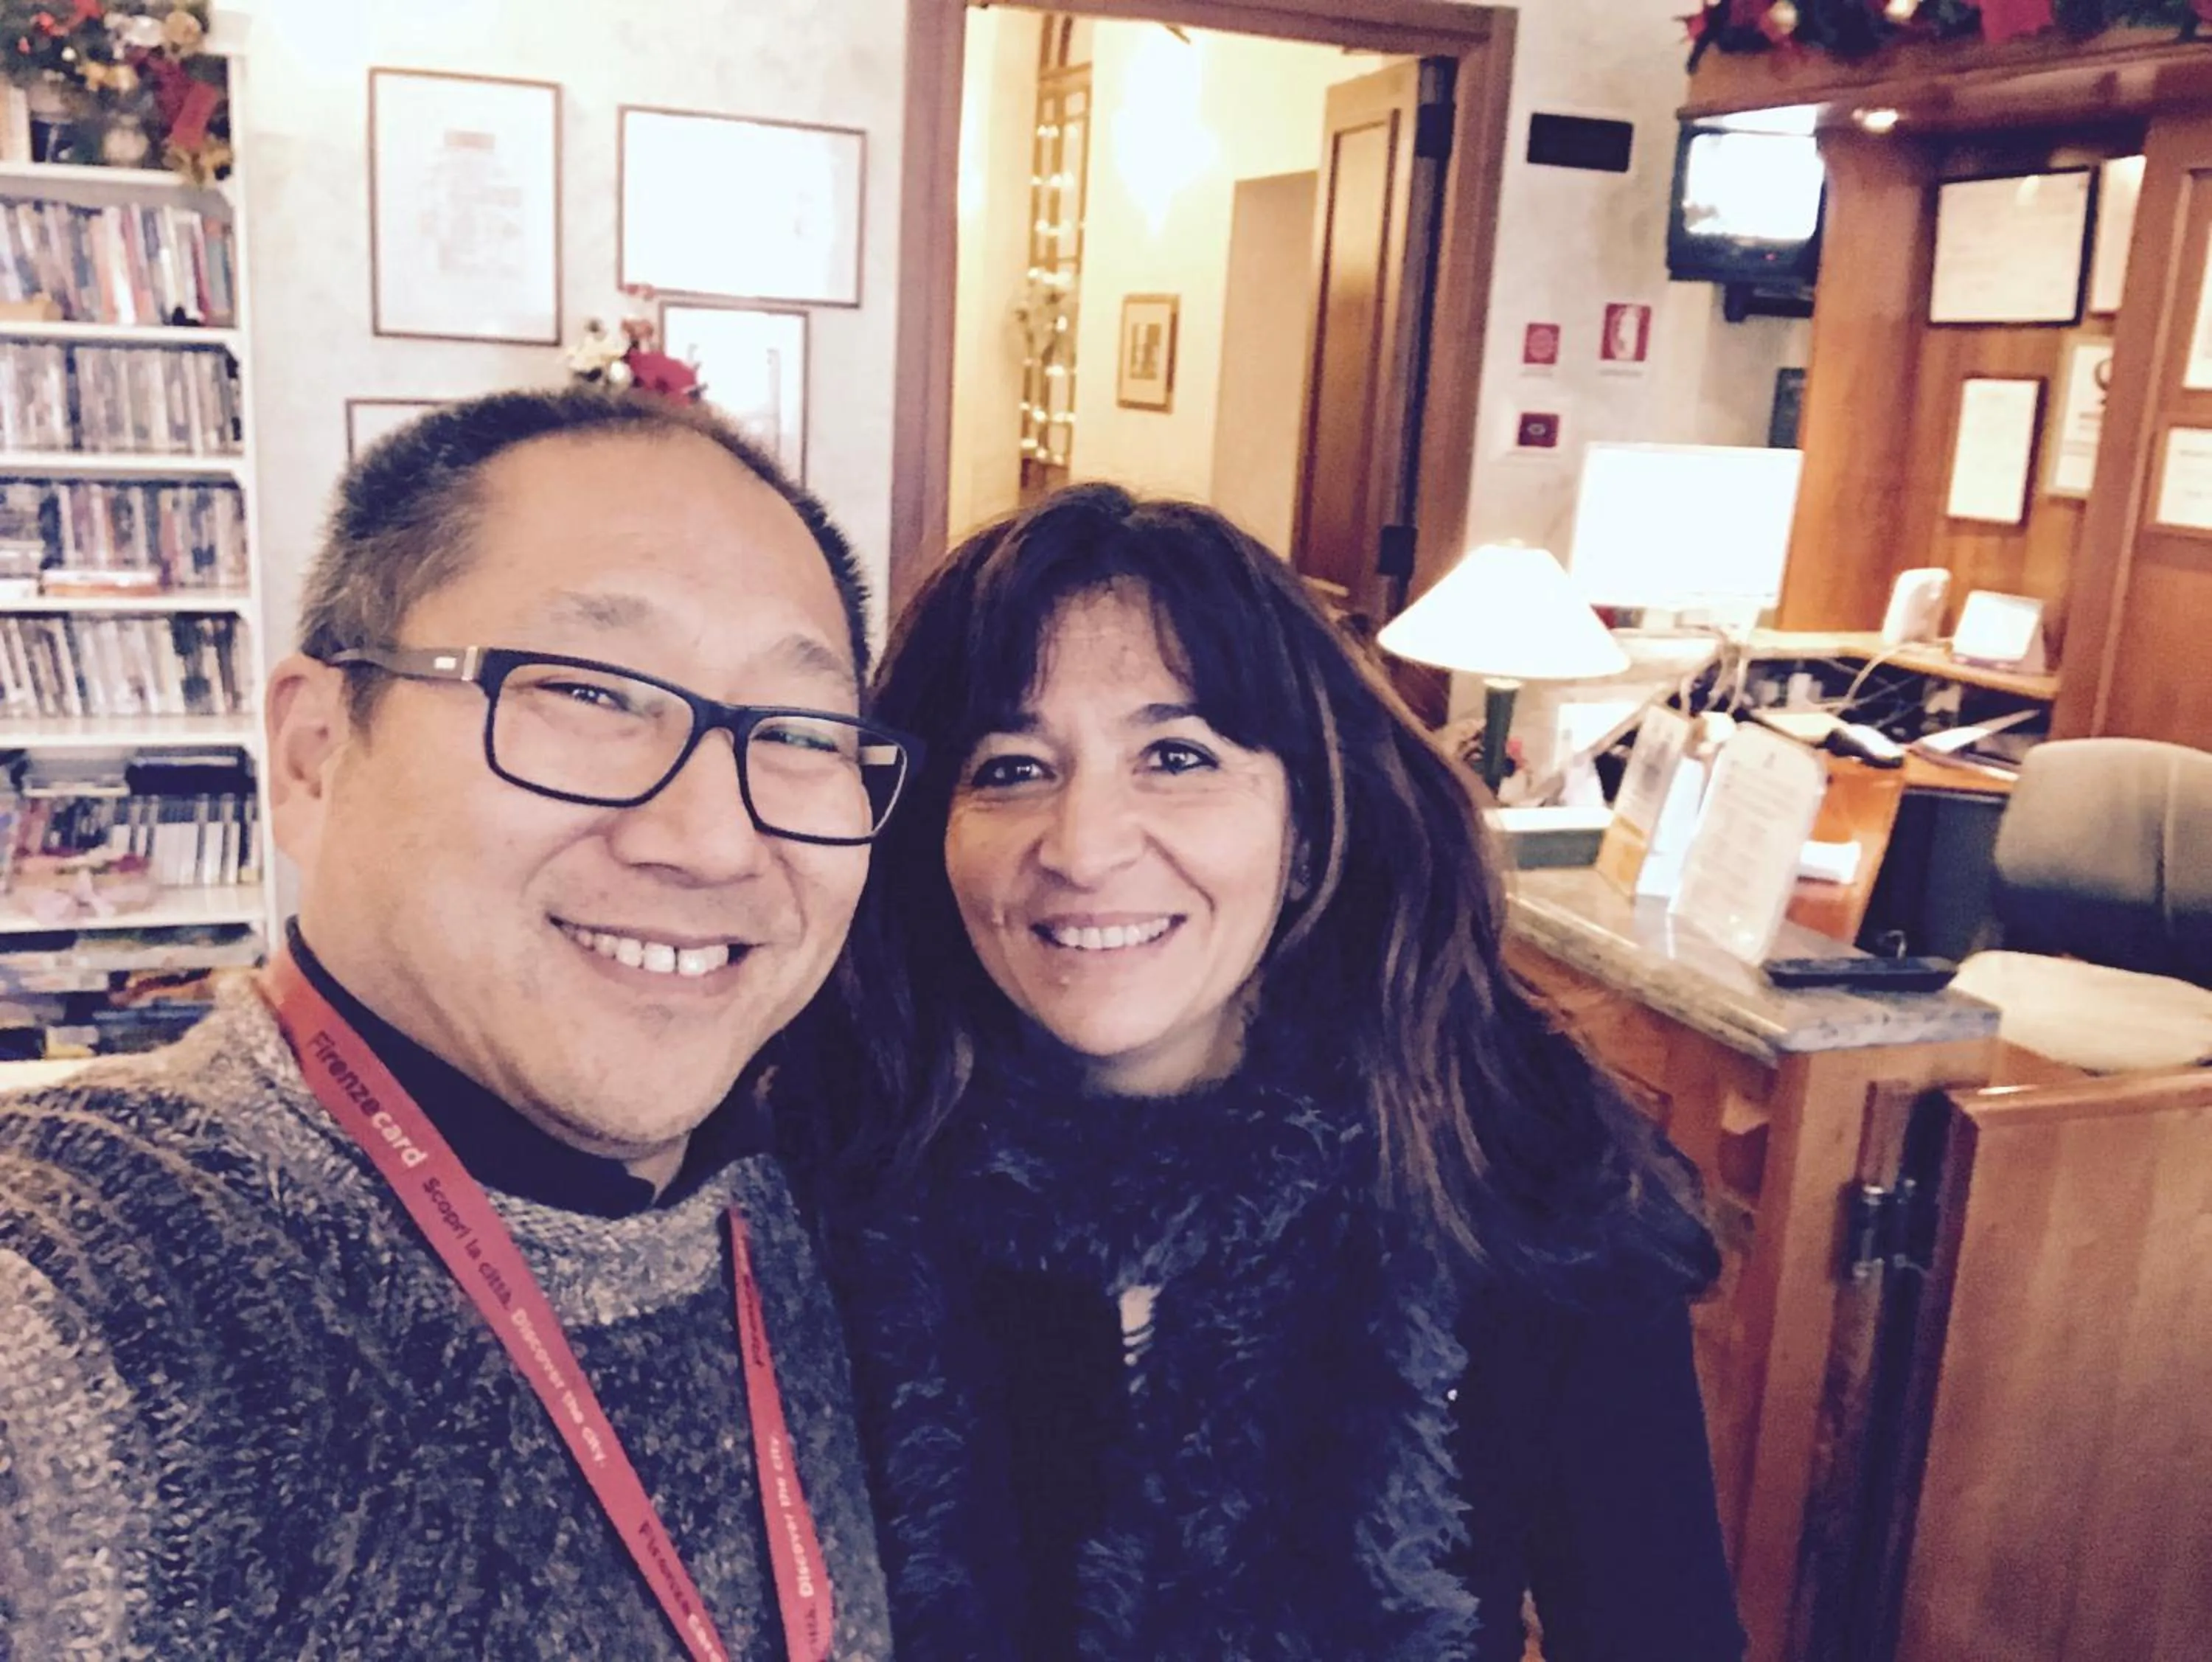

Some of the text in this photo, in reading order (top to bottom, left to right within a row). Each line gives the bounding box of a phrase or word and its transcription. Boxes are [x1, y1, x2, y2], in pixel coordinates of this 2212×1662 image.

[308, 1030, 428, 1168] Firenzecard
[422, 1177, 471, 1240] Scopri
[464, 1238, 482, 1261] la
[511, 1307, 565, 1389] Discover
[562, 1390, 584, 1424] the
[785, 1514, 814, 1597] Discover
